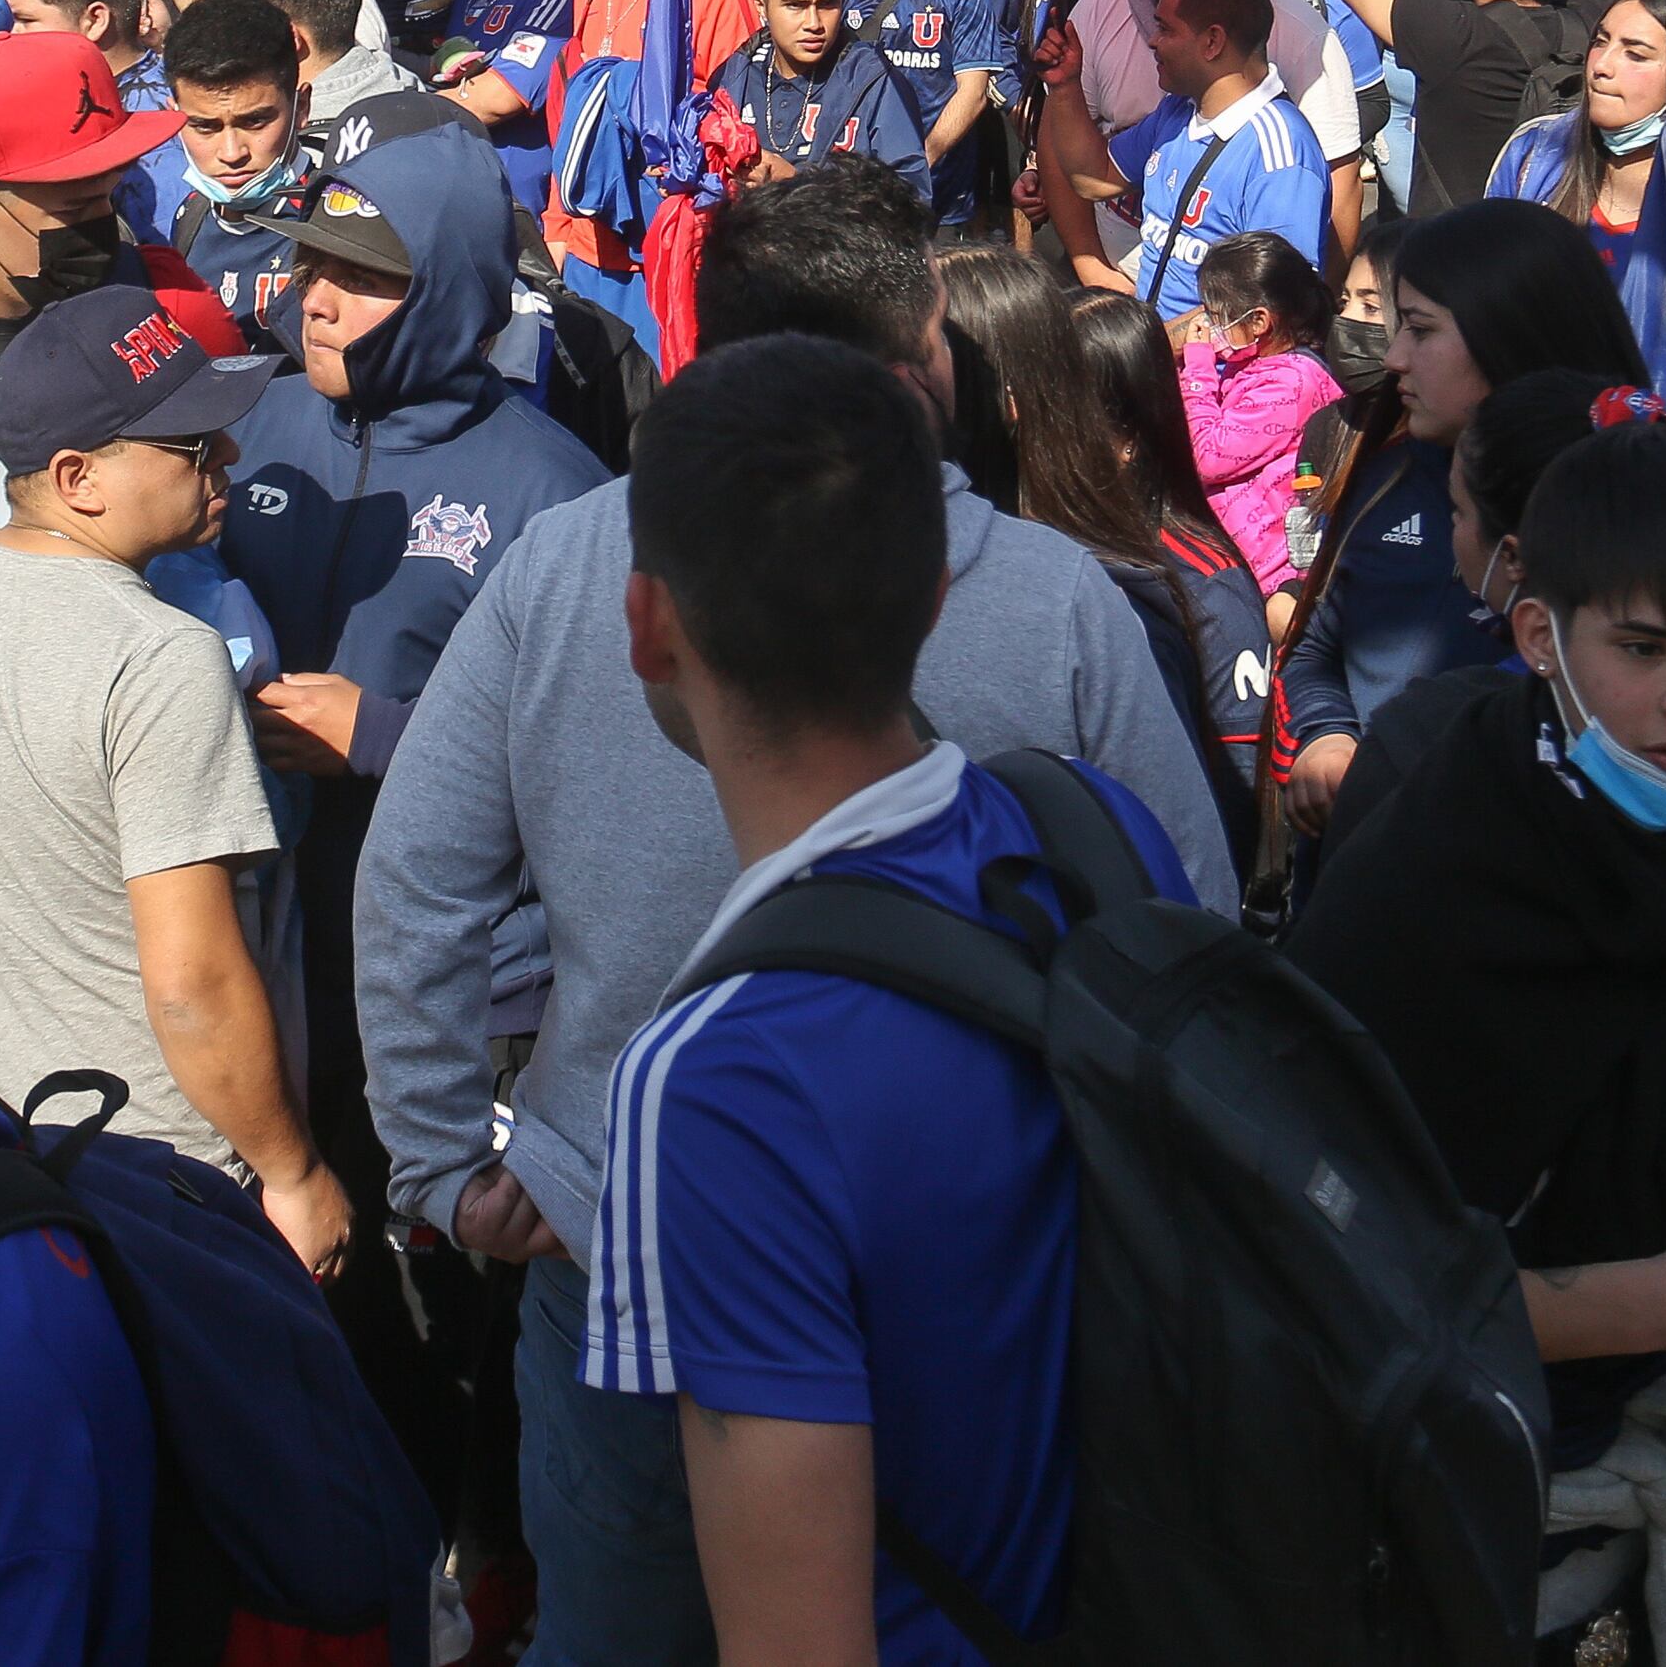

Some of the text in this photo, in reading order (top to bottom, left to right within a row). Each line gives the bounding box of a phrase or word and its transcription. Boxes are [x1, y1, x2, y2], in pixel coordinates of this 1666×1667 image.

[482, 3, 513, 35] U
[912, 13, 944, 49] U
[334, 116, 373, 165] NY
[1381, 532, 1424, 546] adidas
